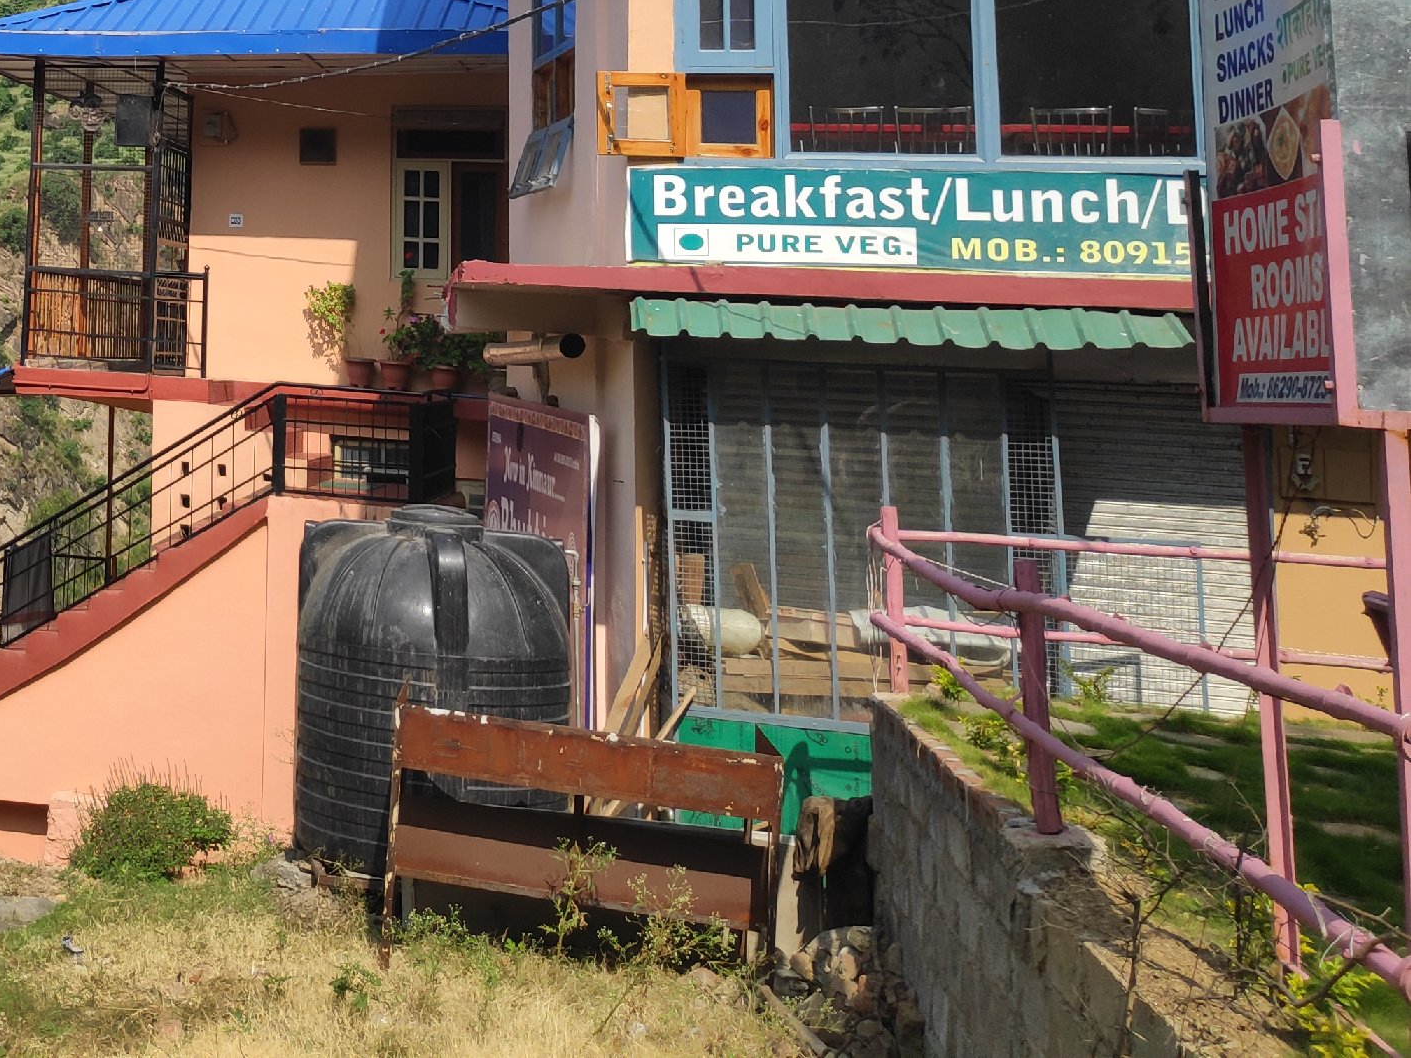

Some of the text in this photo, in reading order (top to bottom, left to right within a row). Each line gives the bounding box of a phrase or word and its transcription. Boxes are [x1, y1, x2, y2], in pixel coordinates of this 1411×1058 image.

[1216, 32, 1275, 83] SNACKS
[1217, 78, 1275, 124] DINNER
[736, 233, 913, 256] PURE VEG.
[951, 237, 1191, 265] MOB.: 80915
[1224, 199, 1289, 256] HOME
[1251, 253, 1324, 310] ROOMS
[1232, 308, 1330, 363] AVAILABL
